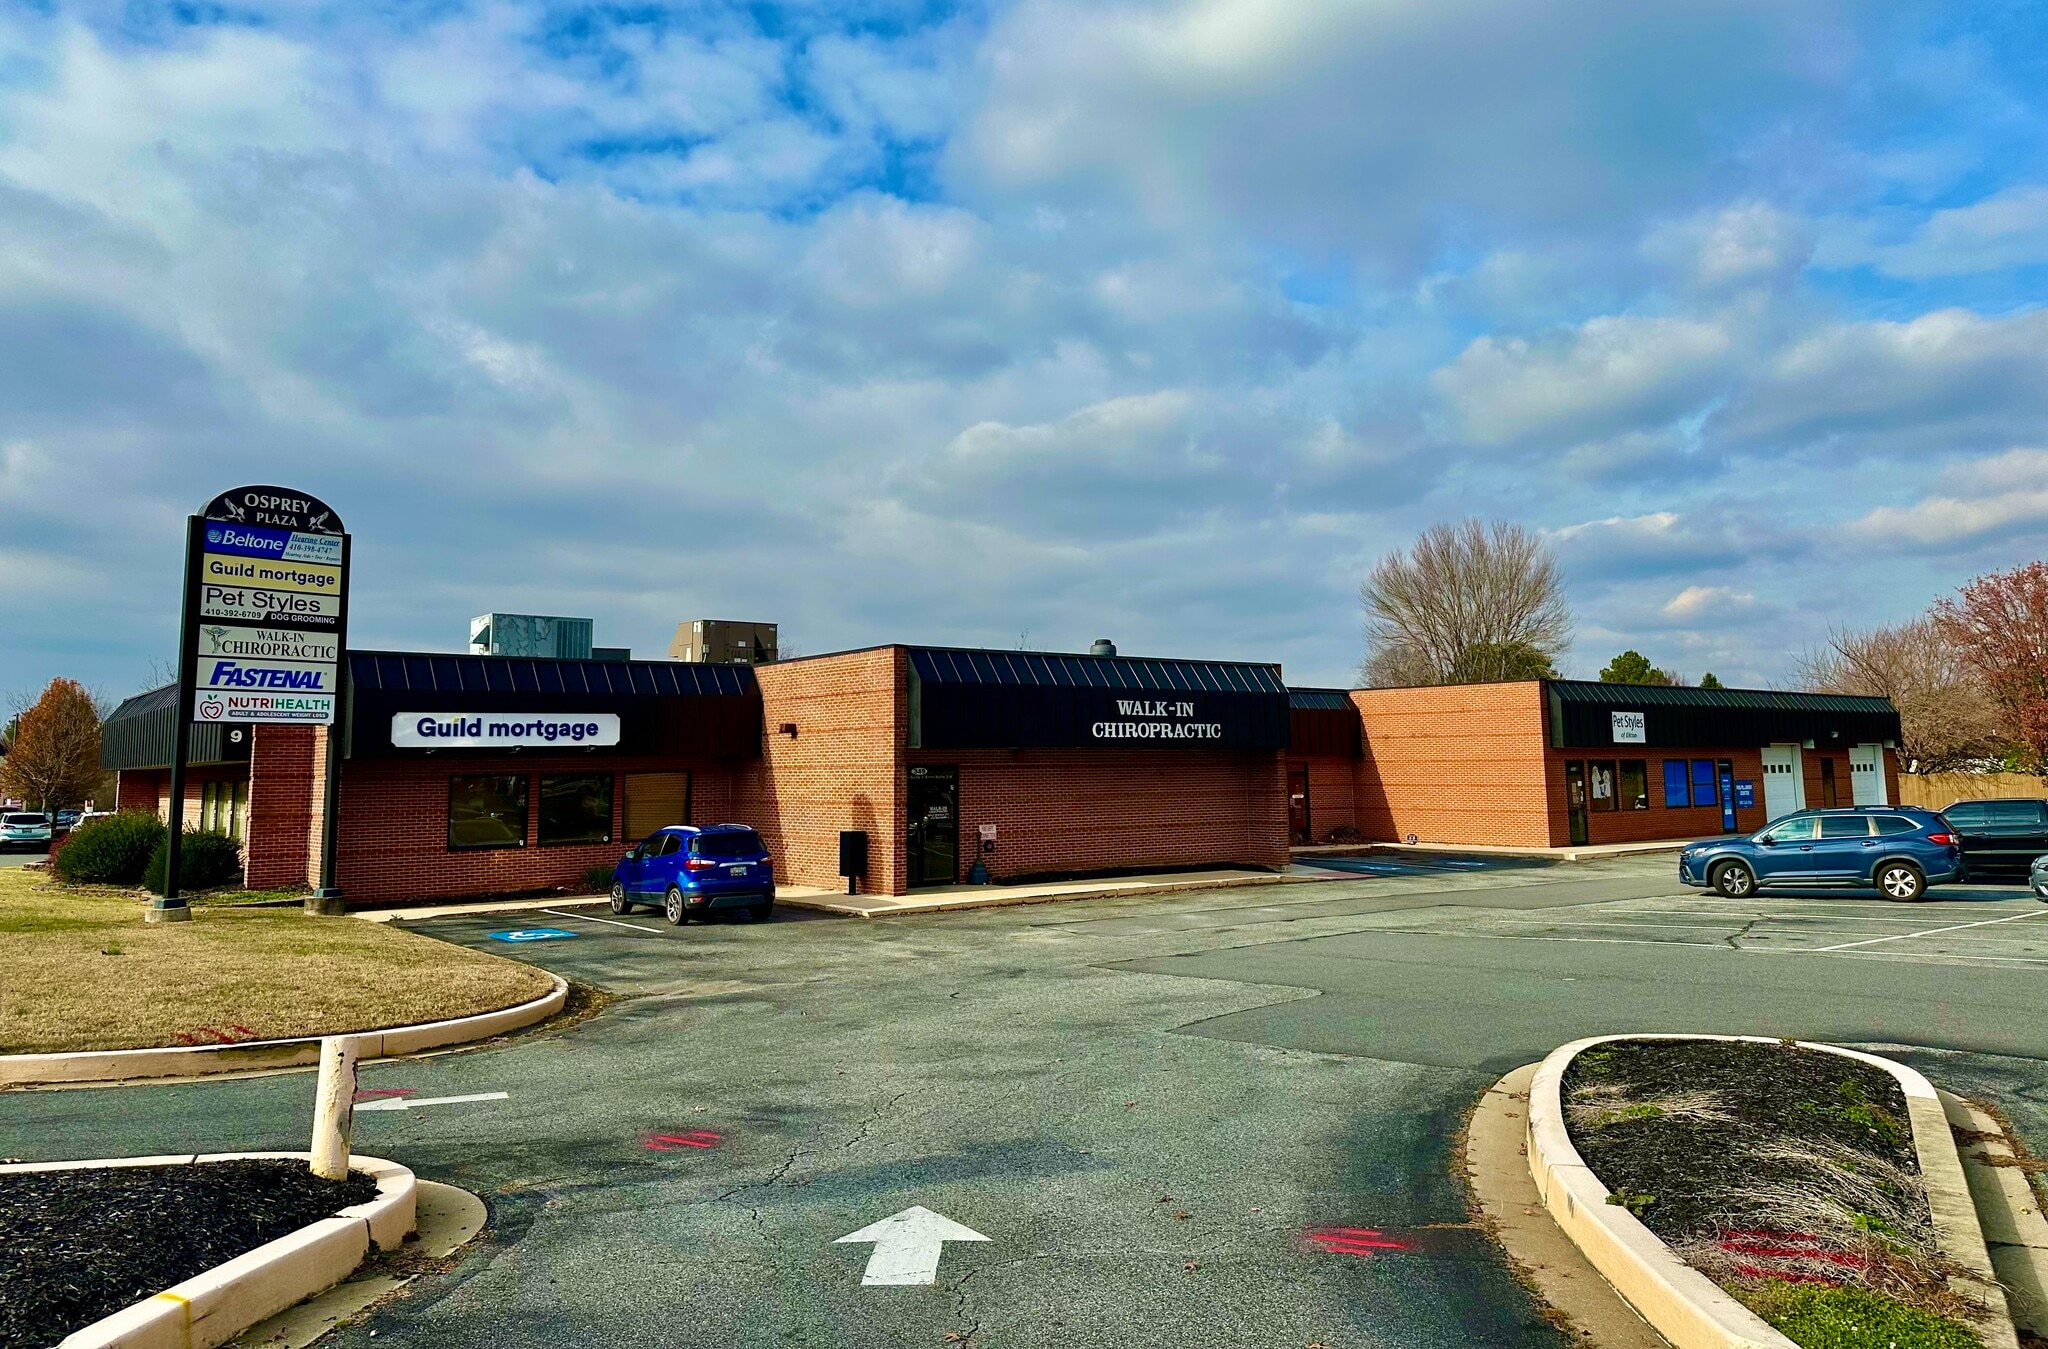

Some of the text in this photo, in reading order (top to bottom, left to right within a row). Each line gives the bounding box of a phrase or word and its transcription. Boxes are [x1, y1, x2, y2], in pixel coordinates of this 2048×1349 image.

[244, 493, 312, 514] OSPREY
[256, 512, 298, 527] PLAZA
[221, 530, 284, 551] Beltone
[289, 543, 333, 554] 410-398-4747
[291, 534, 340, 547] Hearing Center
[209, 561, 335, 587] Guild mortgage
[205, 587, 321, 613] Pet Styles
[205, 608, 262, 619] 410-392-6709
[270, 613, 336, 624] DOG GROOMING
[256, 630, 305, 643] WALK-IN
[221, 640, 336, 659] CHIROPRACTIC
[209, 661, 324, 689] FASTENAL
[228, 696, 331, 711] NUTRIHEALTH
[1116, 699, 1194, 717] WALK-IN
[416, 716, 599, 741] Guild mortgage
[1092, 722, 1221, 739] CHIROPRACTIC
[1613, 714, 1643, 731] Pet Styles
[230, 730, 243, 743] 9
